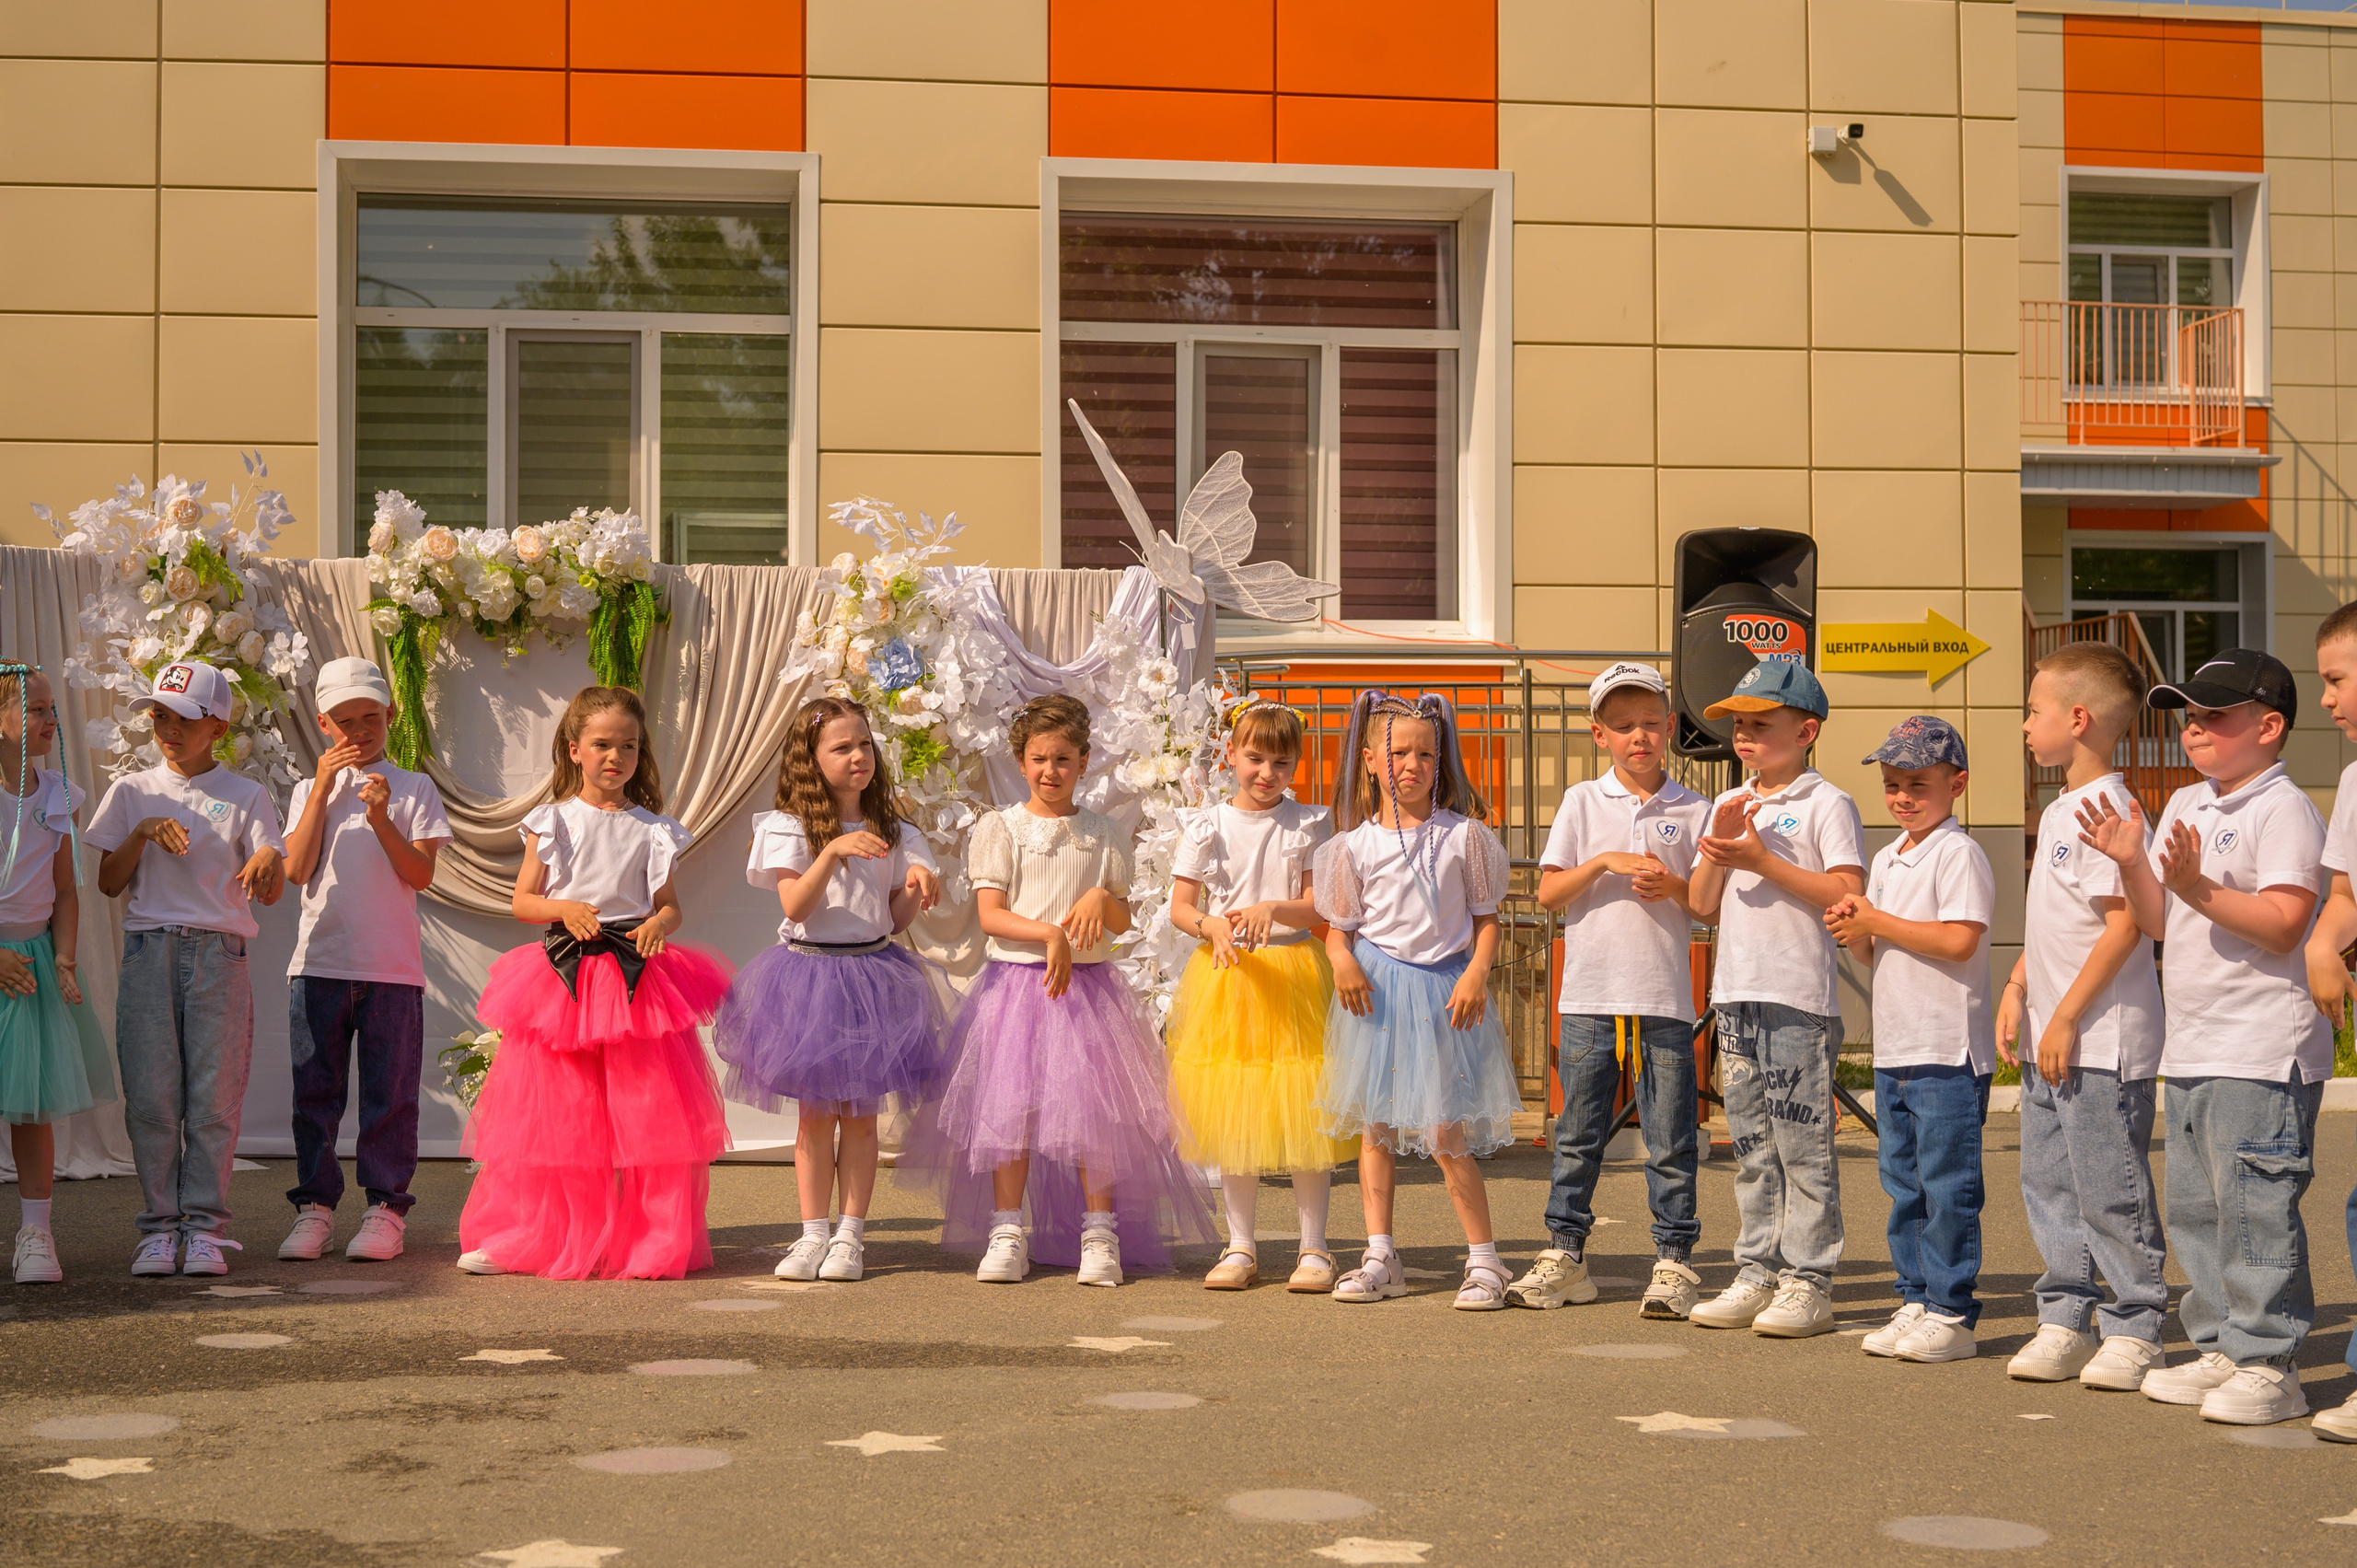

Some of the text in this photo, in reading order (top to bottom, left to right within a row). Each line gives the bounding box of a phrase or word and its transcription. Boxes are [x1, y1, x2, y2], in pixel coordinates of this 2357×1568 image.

[1724, 621, 1789, 643] 1000
[1826, 639, 1969, 655] ЦЕНТРАЛЬНЫЙ ВХОД
[1767, 1097, 1813, 1125] BAND
